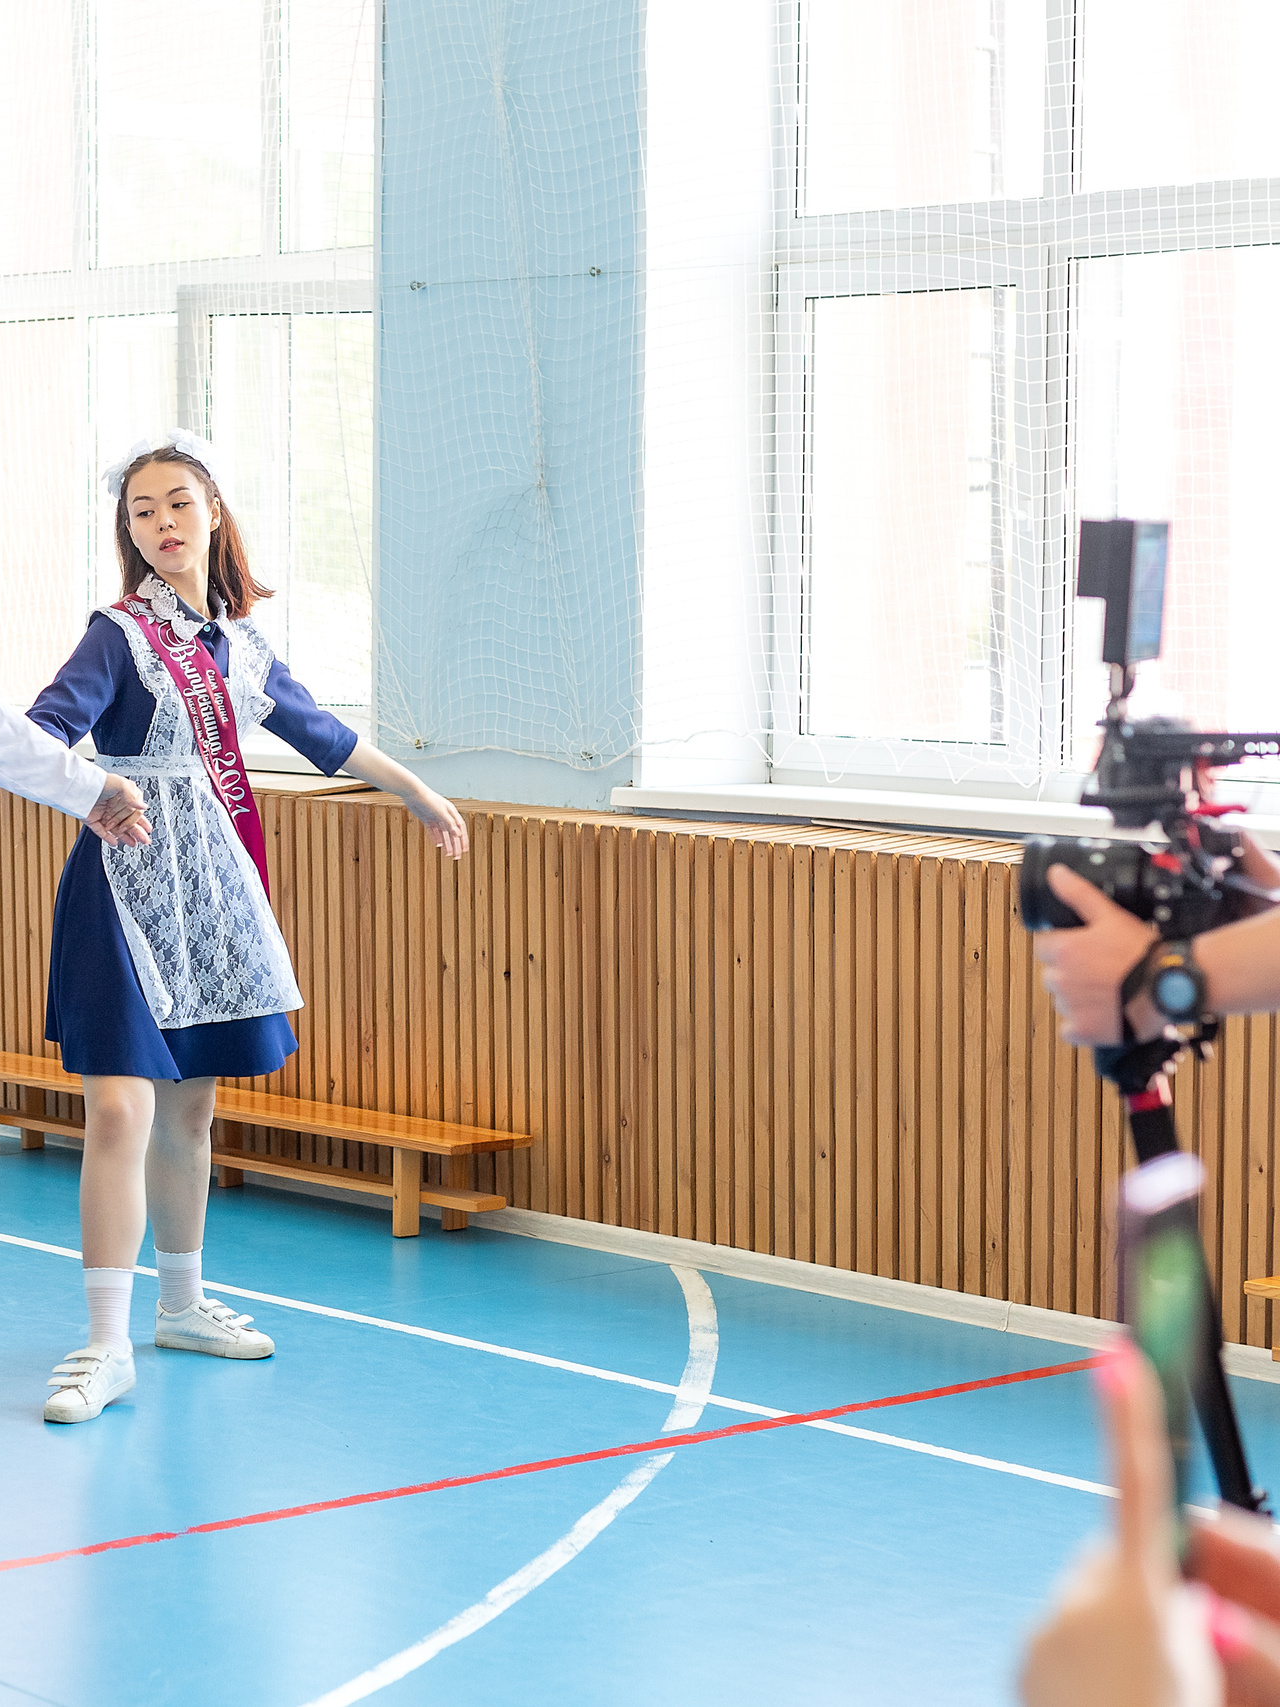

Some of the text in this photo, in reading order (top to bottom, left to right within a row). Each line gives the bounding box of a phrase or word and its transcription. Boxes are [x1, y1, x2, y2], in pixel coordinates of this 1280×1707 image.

[158, 622, 250, 818] Выпускница 2021
[187, 698, 197, 716] МБОУ
[206, 669, 229, 724] Сим Ирина
